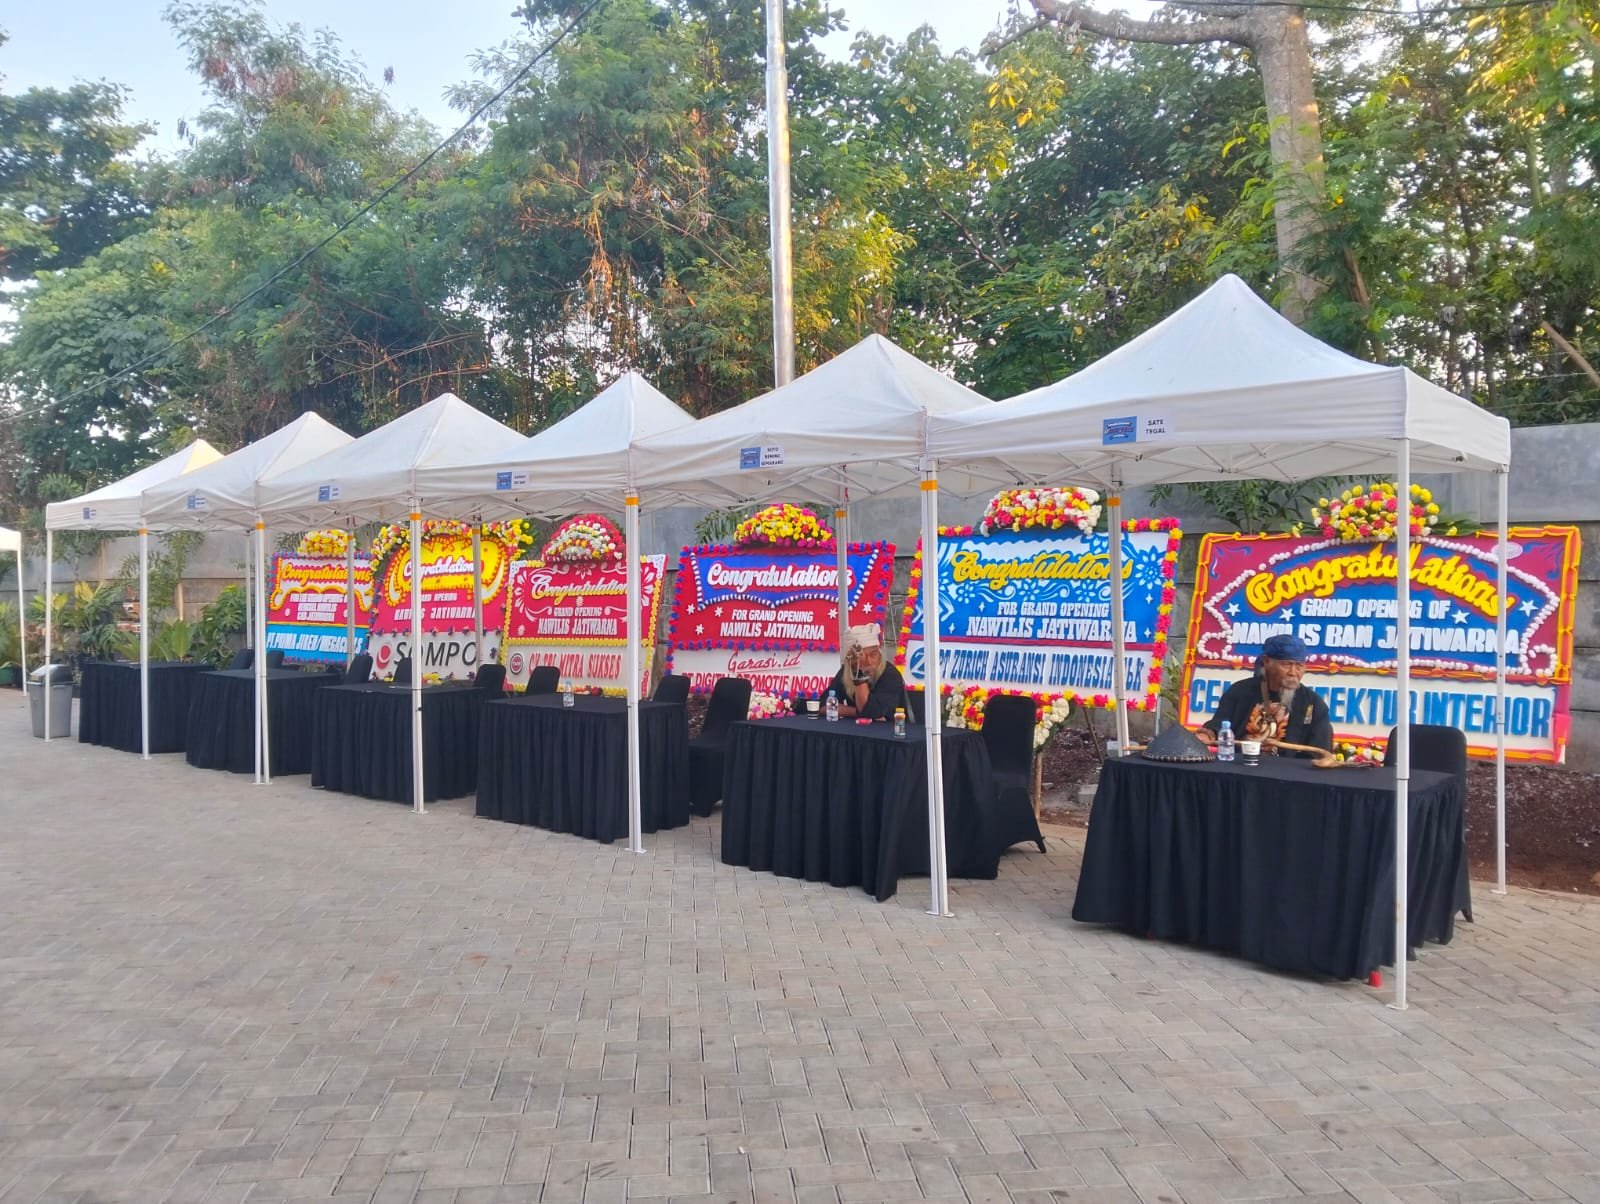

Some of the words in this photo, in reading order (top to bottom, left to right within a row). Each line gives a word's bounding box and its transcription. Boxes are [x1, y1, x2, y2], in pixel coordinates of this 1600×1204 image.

[950, 550, 1133, 590] Congratulatios
[531, 574, 627, 606] Congratulation
[732, 609, 748, 621] FOR
[749, 609, 777, 622] GRAND
[777, 611, 814, 623] OPENING
[997, 602, 1017, 616] FOR
[1020, 602, 1056, 617] GRAND
[1060, 603, 1109, 618] OPENING
[1301, 599, 1349, 618] GRAND
[1357, 599, 1423, 620] OPENG
[1428, 600, 1451, 619] OF
[720, 621, 763, 637] NAWILIS
[764, 624, 825, 640] JATIWARNA
[966, 617, 1033, 639] NAWILIS
[1037, 618, 1137, 643] JATIWARA
[1325, 623, 1374, 649] BAN
[1377, 625, 1520, 655] JTIWARNA
[586, 654, 622, 680] SUKSES
[727, 651, 801, 672] Garasi.id
[950, 649, 990, 681] ZURICH
[989, 651, 1047, 685] ASURANSI
[1049, 654, 1114, 690] INDONESIA
[1423, 691, 1551, 738] INTERIOR
